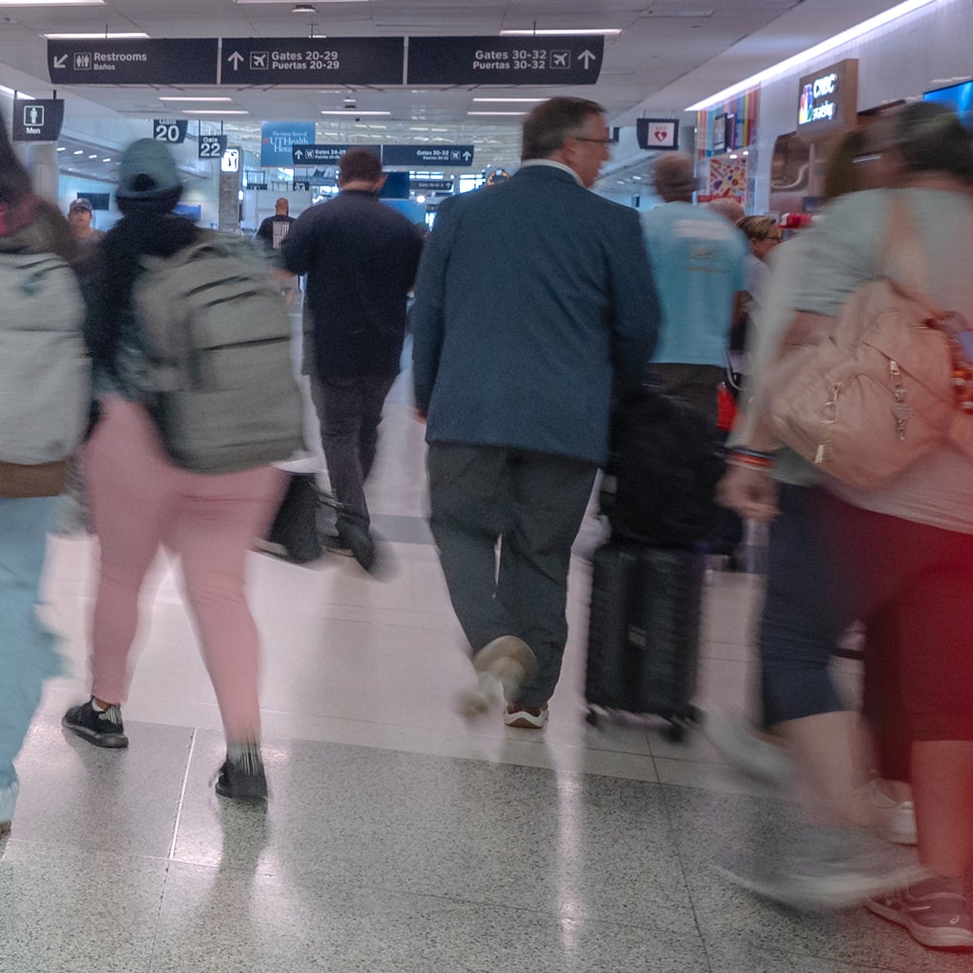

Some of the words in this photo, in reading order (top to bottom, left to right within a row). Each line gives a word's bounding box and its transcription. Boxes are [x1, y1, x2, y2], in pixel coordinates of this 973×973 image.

[94, 52, 147, 62] Restrooms
[272, 51, 303, 60] Gates
[306, 51, 338, 60] 20-29
[475, 50, 508, 59] Gates
[512, 50, 547, 59] 30-32
[272, 61, 307, 70] Puertas
[309, 61, 339, 69] 20-29
[473, 61, 510, 70] Puertas
[513, 61, 545, 69] 30-32
[26, 127, 41, 135] Men
[156, 125, 179, 141] 20
[200, 144, 221, 157] 22
